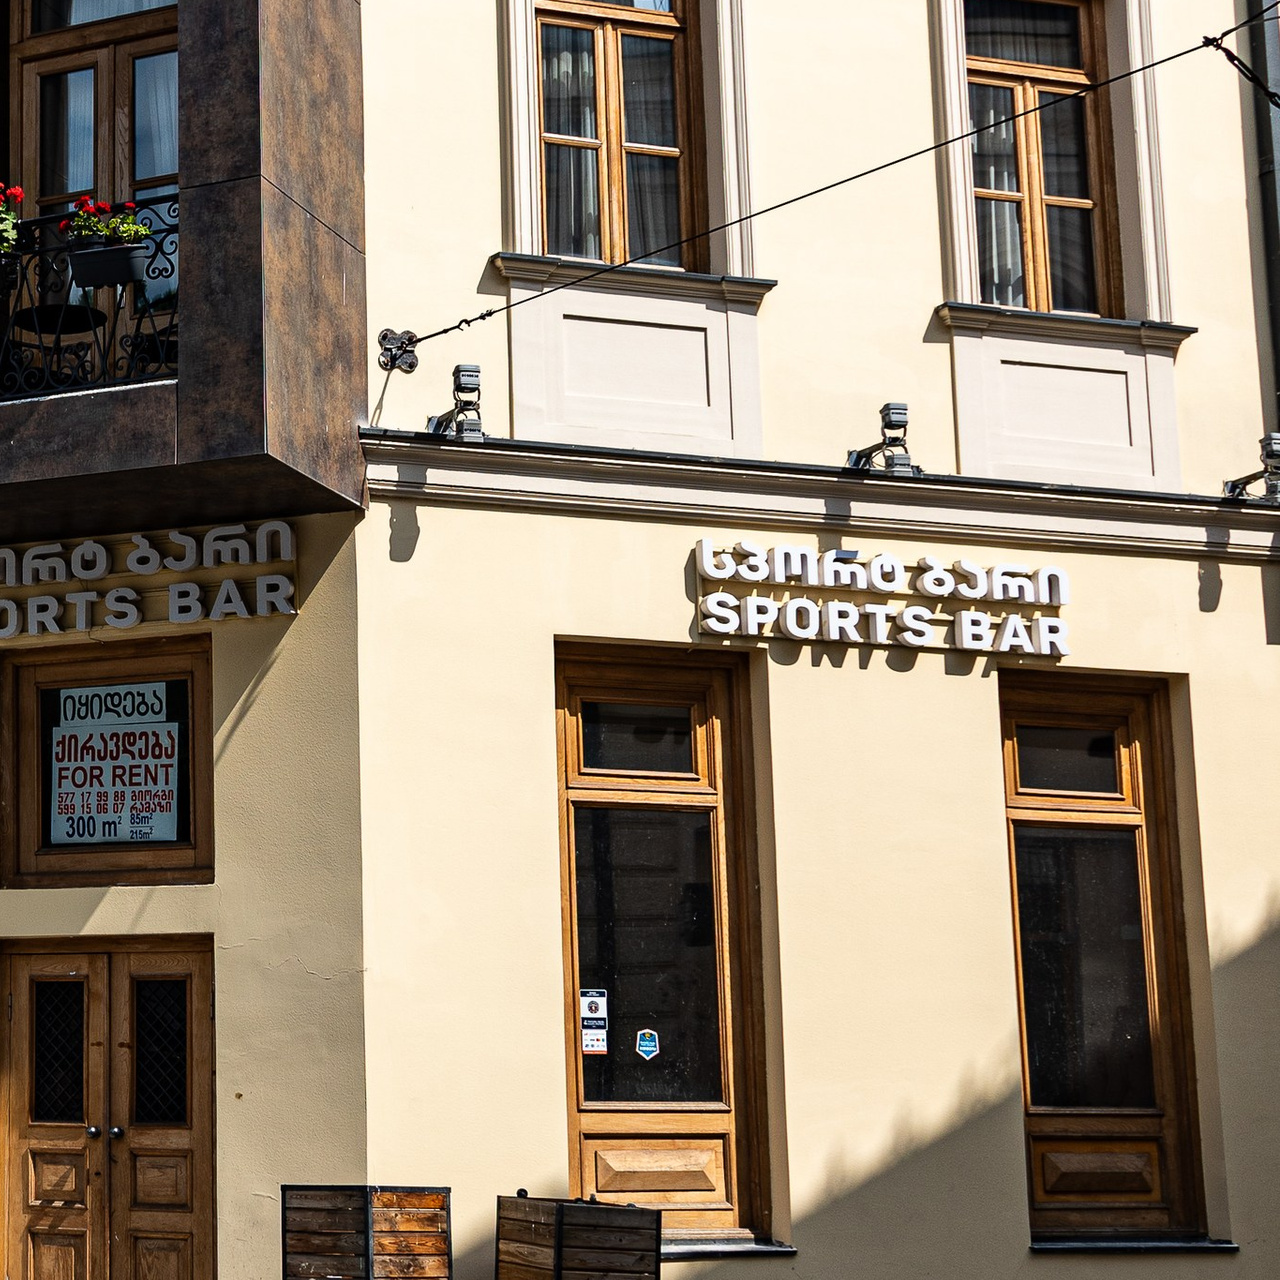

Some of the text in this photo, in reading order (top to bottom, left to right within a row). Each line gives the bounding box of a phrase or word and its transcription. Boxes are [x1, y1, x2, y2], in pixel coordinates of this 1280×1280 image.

[126, 521, 297, 575] ბარი
[696, 538, 1071, 606] სპორტ ბარი
[168, 575, 297, 624] BAR
[698, 592, 1071, 656] SPORTS BAR
[62, 689, 164, 722] იყიდება
[54, 730, 176, 764] ქირავდება
[57, 763, 174, 789] FOR RENT
[57, 792, 76, 803] 577
[80, 791, 92, 803] 17
[96, 791, 109, 802] 99
[130, 789, 174, 802] გიორგი
[57, 801, 173, 815] 599 15 06 07 რამაზი
[65, 816, 96, 839] 300
